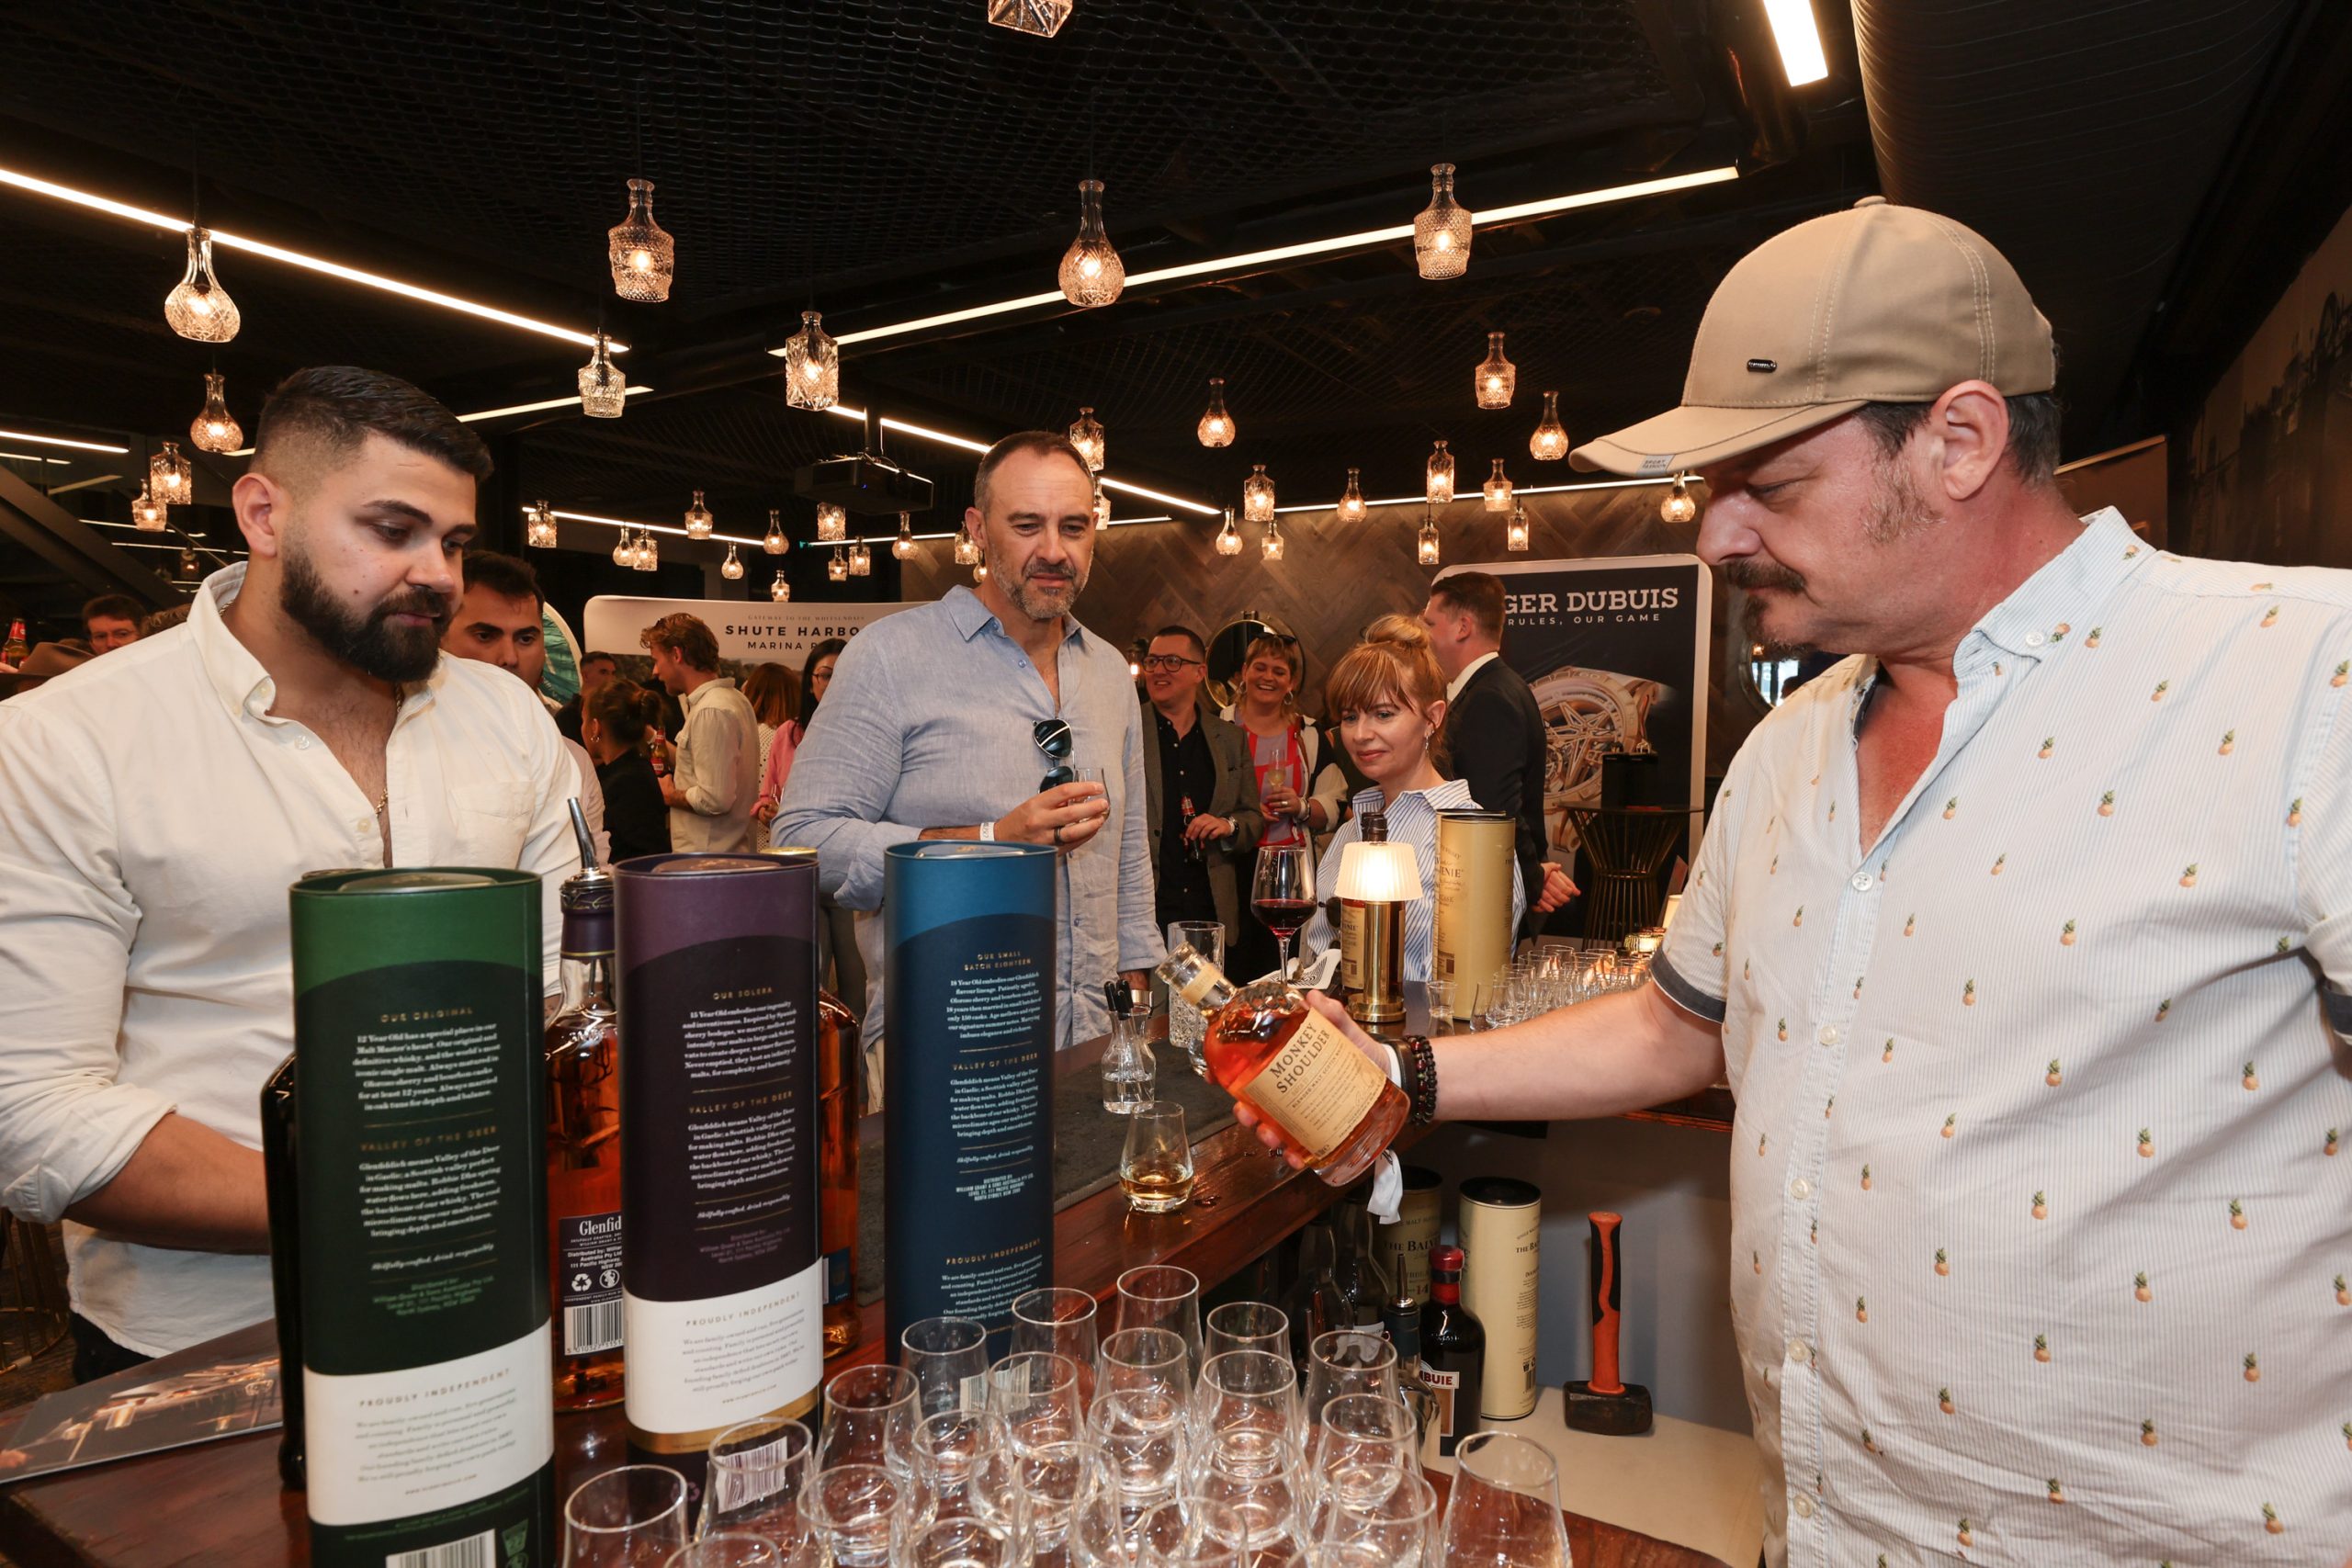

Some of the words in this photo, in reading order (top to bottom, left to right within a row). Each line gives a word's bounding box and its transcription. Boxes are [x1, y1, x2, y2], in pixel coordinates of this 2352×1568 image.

[1566, 588, 1679, 612] DUBUIS
[1508, 617, 1563, 626] RULES,
[1574, 615, 1606, 624] OUR
[1616, 614, 1660, 622] GAME
[726, 626, 787, 637] SHUTE
[748, 641, 802, 650] MARINA
[994, 959, 1031, 967] EIGHTEEN
[738, 987, 773, 997] SOLERA
[380, 1013, 406, 1022] OUR
[412, 1008, 472, 1020] ORIGINAL
[1270, 1023, 1317, 1077] MONKEY
[1276, 1030, 1329, 1093] SHOULDER
[772, 1091, 793, 1101] DEER
[360, 1141, 408, 1150] VALLEY
[437, 1133, 461, 1141] THE
[467, 1126, 497, 1137] DEER
[580, 1215, 622, 1235] Glenfid
[567, 1249, 597, 1258] Distributed
[945, 1256, 986, 1264] PROUDLY
[990, 1239, 1040, 1260] INDEPENDENT
[1417, 1284, 1429, 1294] 14
[685, 1314, 733, 1325] PROUDLY
[739, 1292, 799, 1317] INDEPENDENT
[359, 1394, 417, 1406] PROUDLY
[424, 1369, 509, 1398] INDEPENDENT
